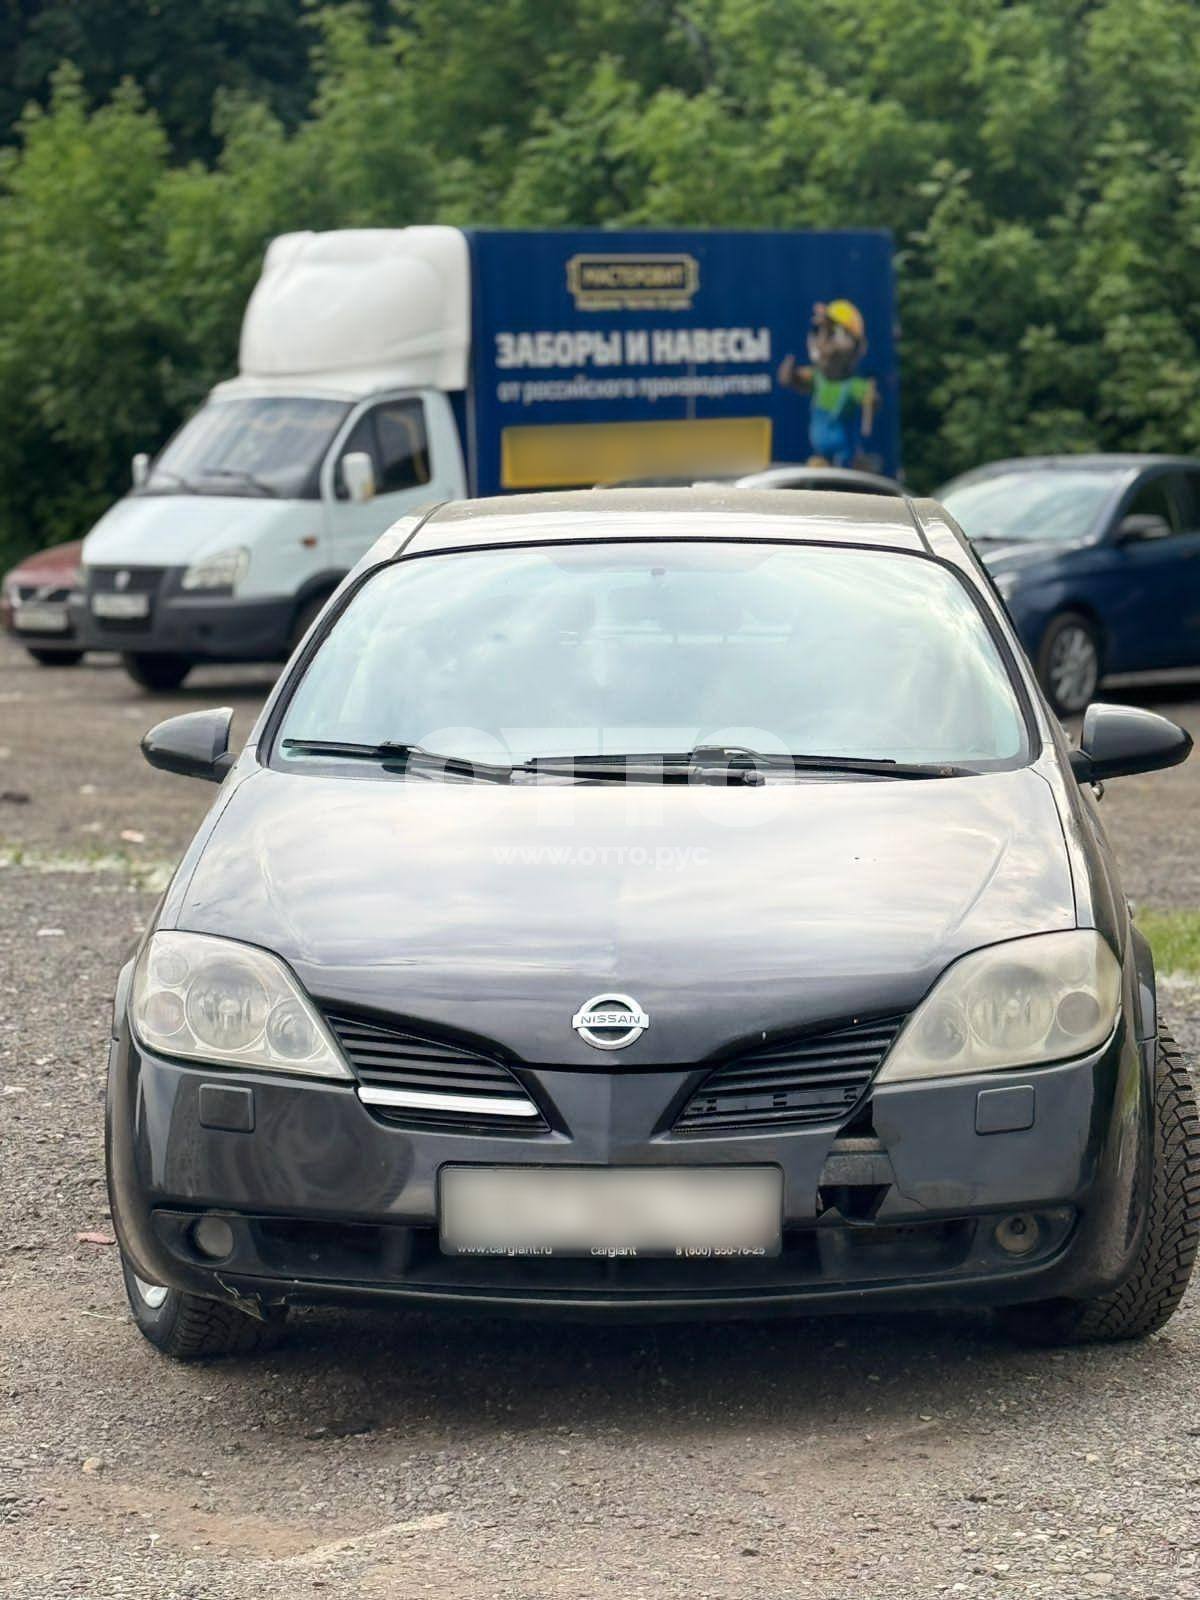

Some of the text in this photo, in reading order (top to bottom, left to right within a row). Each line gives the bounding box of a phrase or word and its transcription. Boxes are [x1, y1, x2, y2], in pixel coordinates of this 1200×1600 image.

[495, 328, 771, 368] ЗАБОРЫ И НАВЕСЫ
[497, 382, 521, 402] от
[523, 376, 635, 405] российского
[580, 1014, 641, 1025] NISSAN
